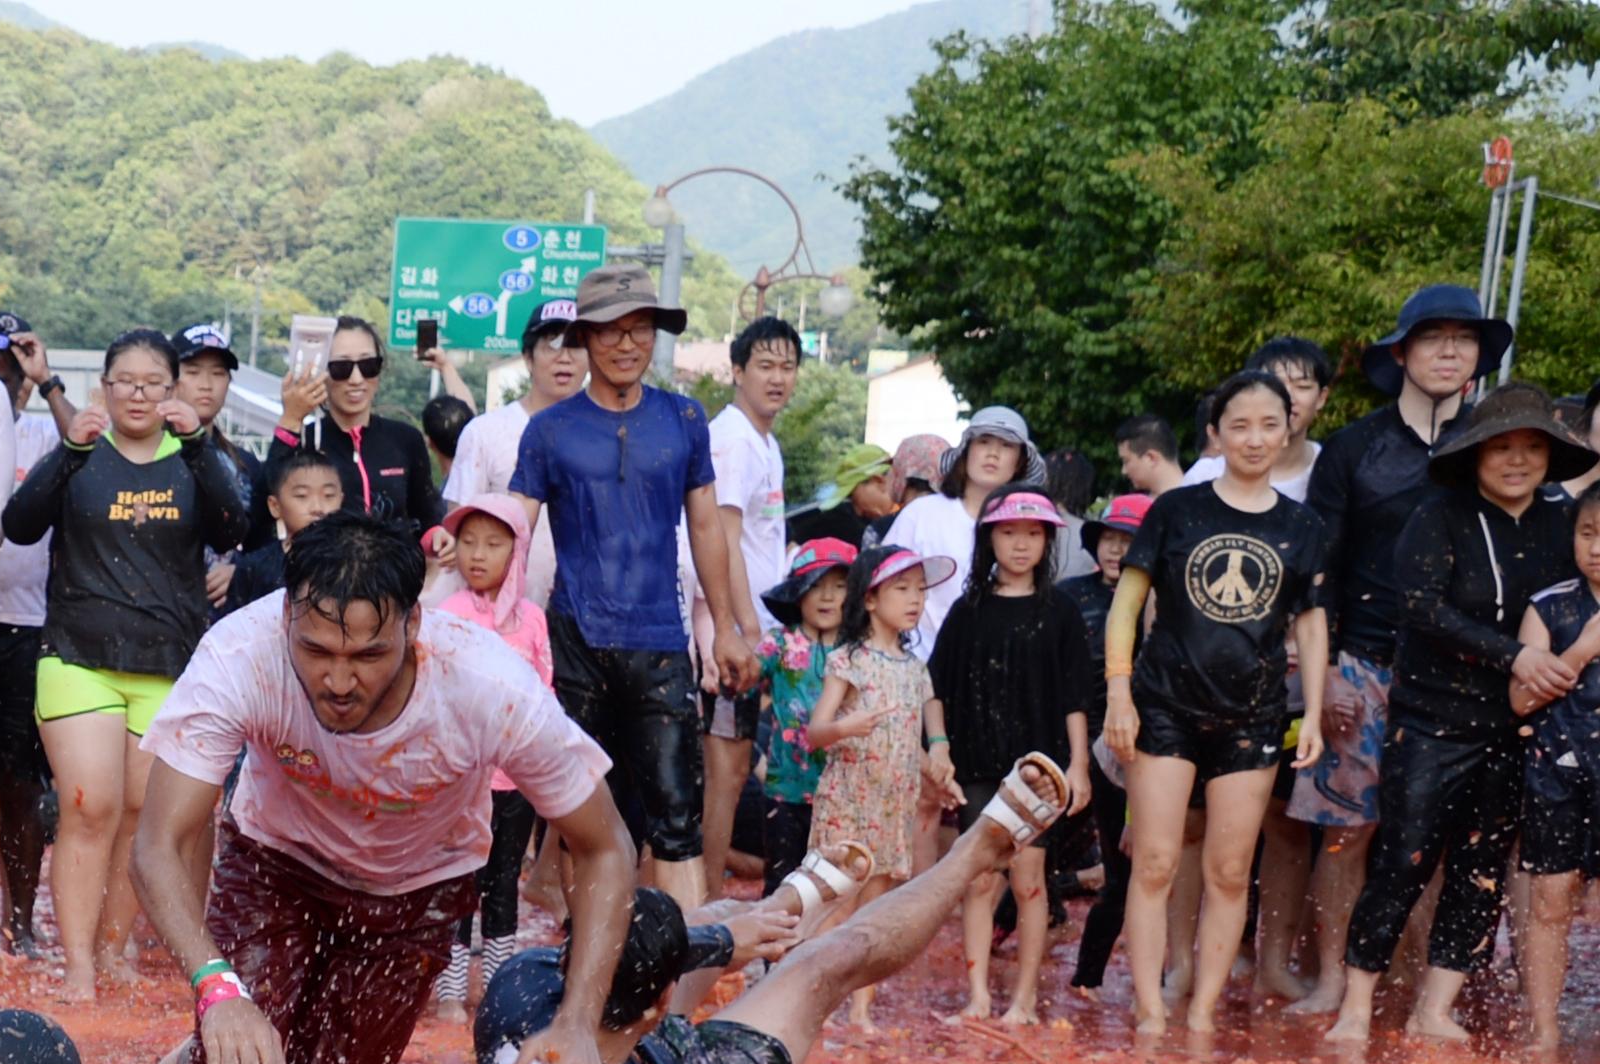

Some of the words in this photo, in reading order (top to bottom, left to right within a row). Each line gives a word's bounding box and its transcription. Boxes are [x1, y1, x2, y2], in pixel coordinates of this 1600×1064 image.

[516, 230, 527, 246] 5
[543, 230, 581, 249] 춘천
[401, 267, 438, 286] 김화
[542, 265, 579, 286] 화천
[616, 278, 632, 292] S
[468, 299, 492, 312] 56
[117, 488, 174, 504] Hello!
